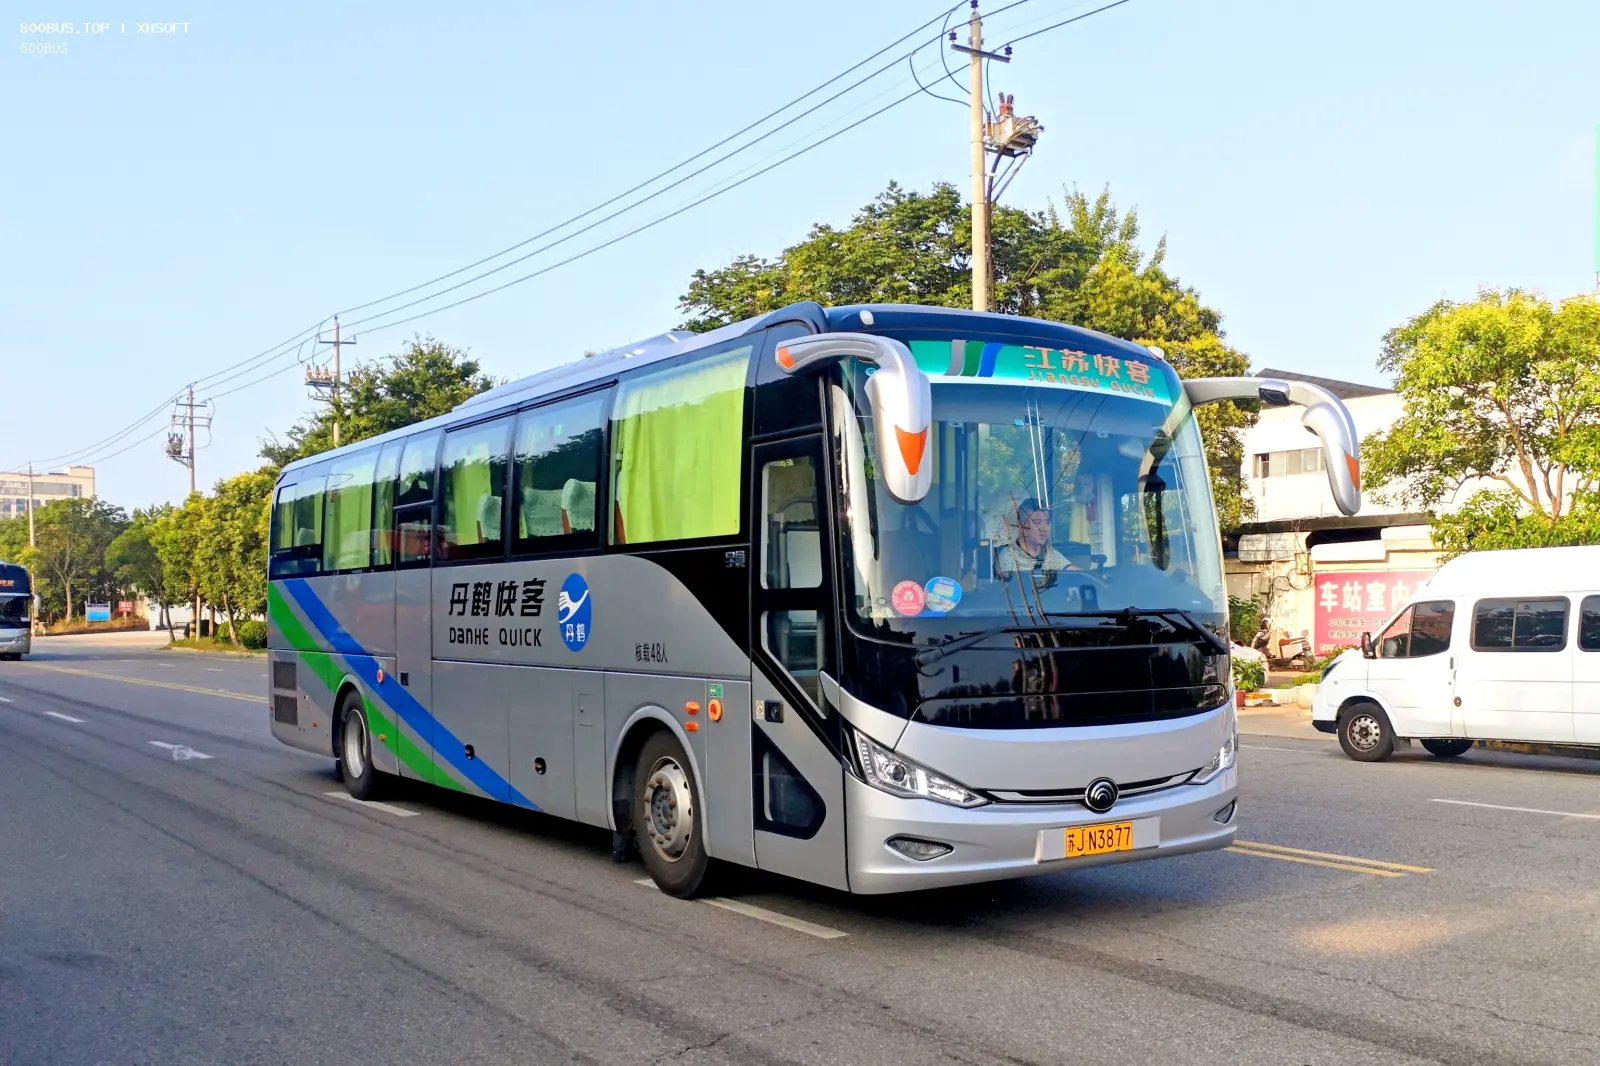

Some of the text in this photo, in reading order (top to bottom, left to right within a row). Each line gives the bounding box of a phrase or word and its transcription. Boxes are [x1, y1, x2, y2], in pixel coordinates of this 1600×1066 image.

[1023, 345, 1152, 385] 江苏快客
[448, 578, 547, 618] 丹鹤快客
[1319, 580, 1424, 613] 车站室内
[499, 627, 542, 648] QUICK
[565, 623, 586, 643] 丹鹤
[635, 642, 668, 664] 核载48人
